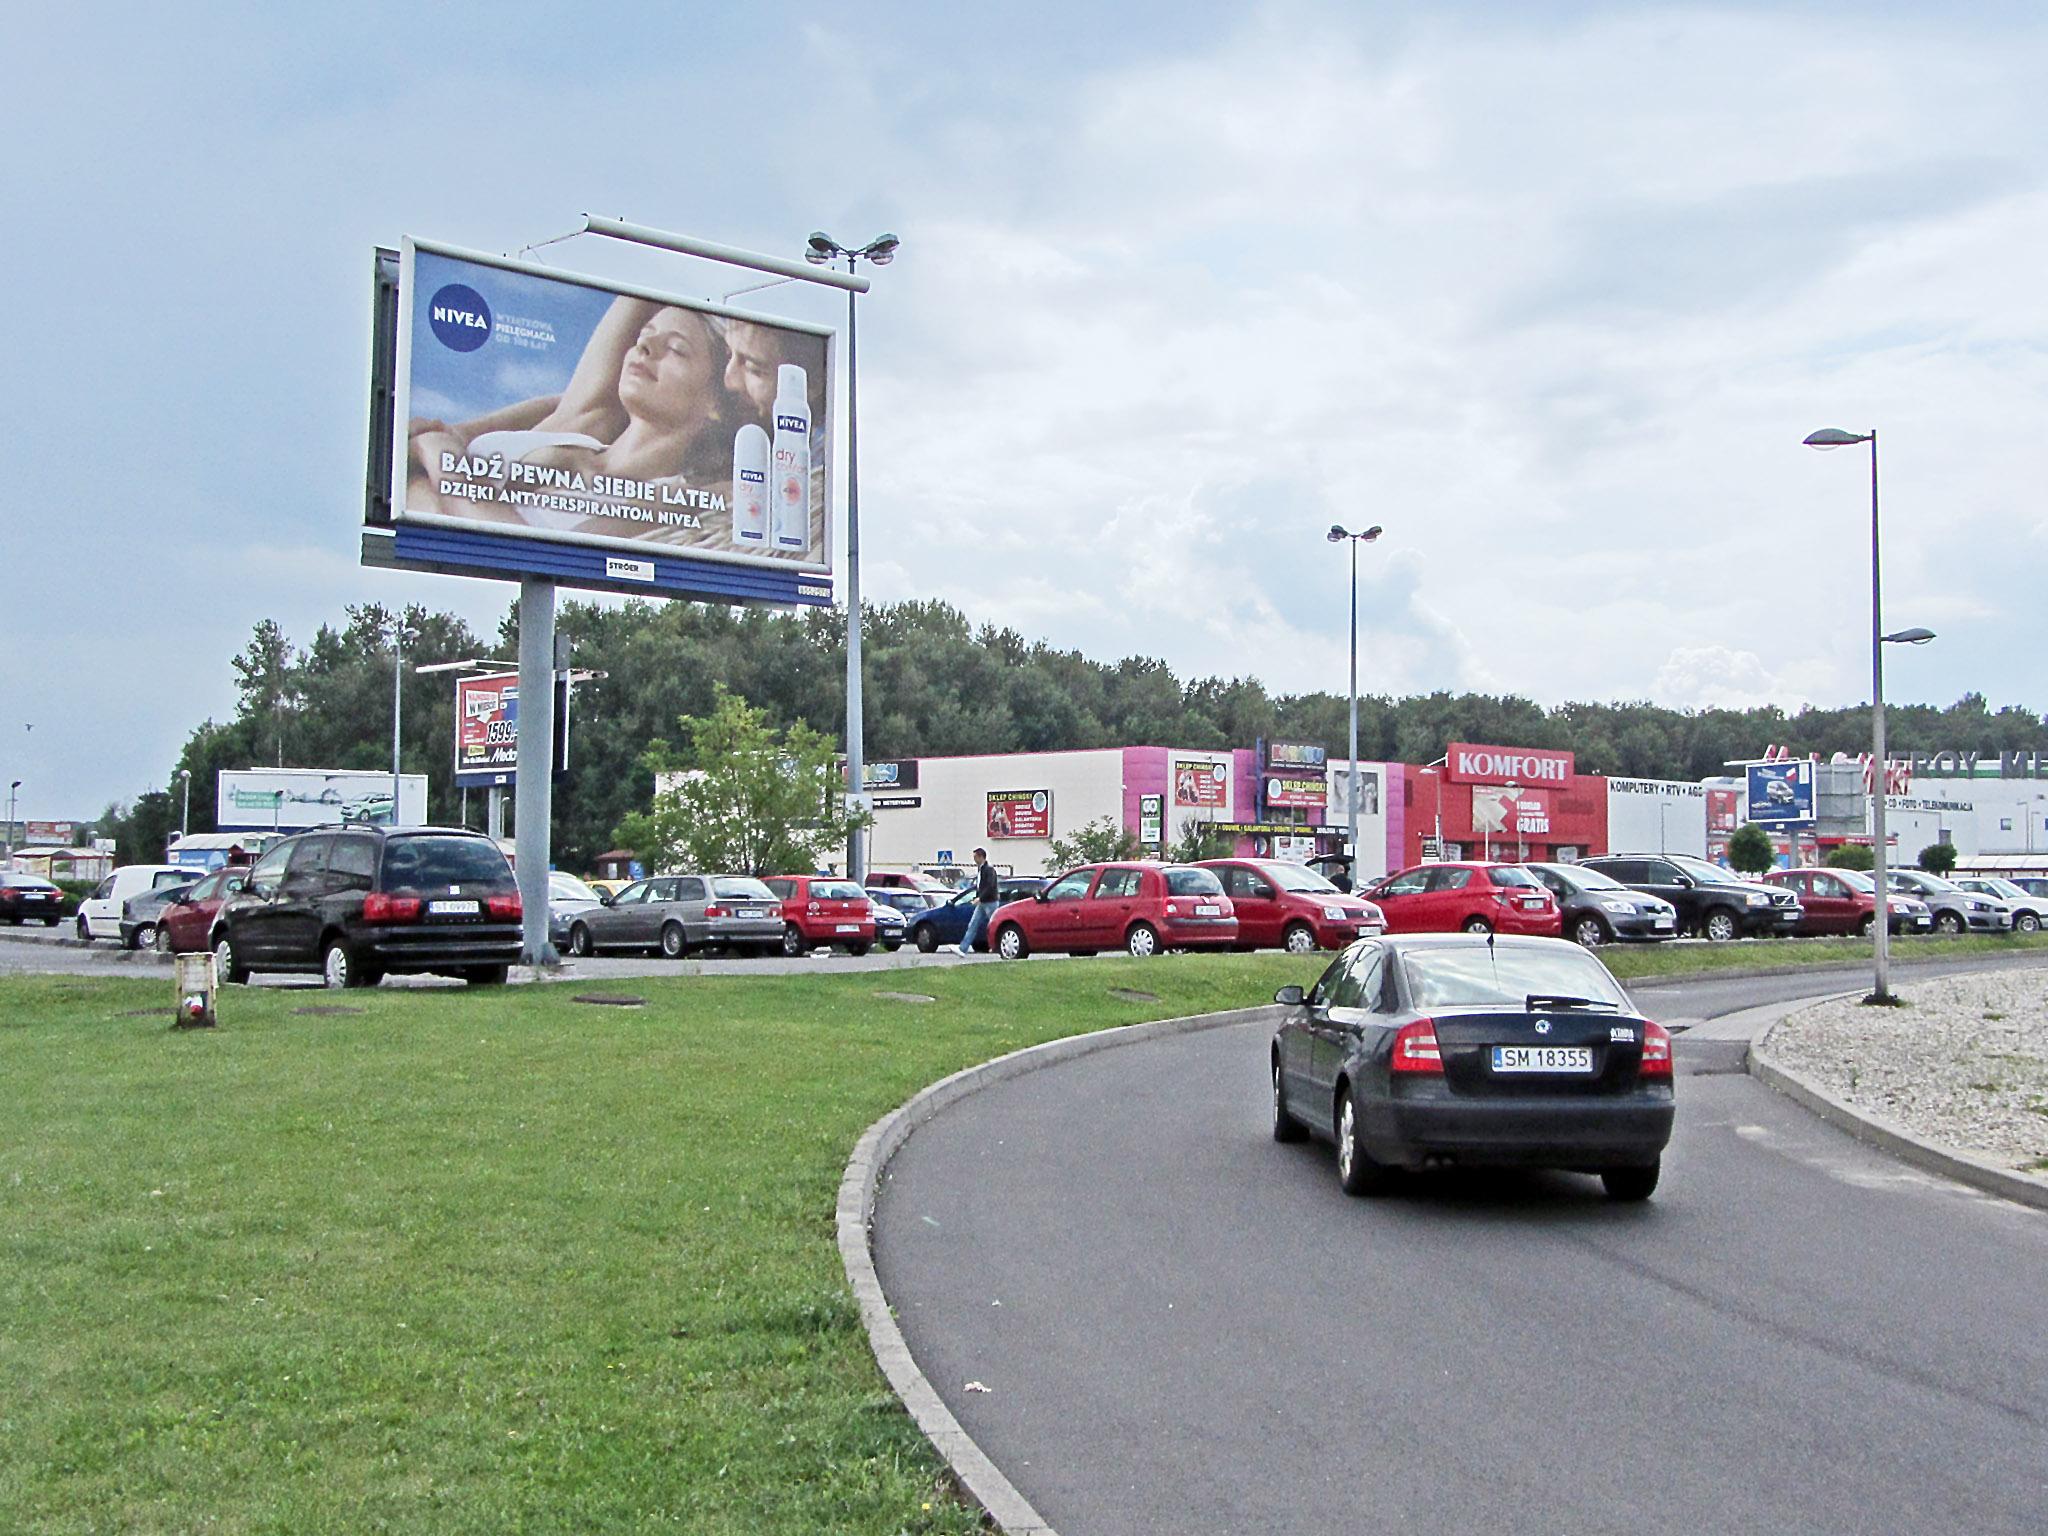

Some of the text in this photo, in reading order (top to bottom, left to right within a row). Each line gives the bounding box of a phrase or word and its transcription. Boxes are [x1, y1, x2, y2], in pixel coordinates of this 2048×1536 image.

[433, 305, 488, 330] NIVEA
[778, 418, 805, 431] NIVEA
[776, 449, 795, 463] dry
[441, 452, 726, 512] BĄDŹ PEWNA SIEBIE LATEM
[742, 472, 763, 482] NIVEA
[440, 480, 702, 529] DZIĘKI ANTYPERSPIRANTOM NIVEA
[1458, 752, 1569, 781] KOMFORT
[1610, 780, 1660, 795] KOMPUTERY
[1666, 784, 1681, 796] RTV
[1516, 817, 1549, 834] GRATIS
[1504, 1049, 1589, 1067] SM 18355
